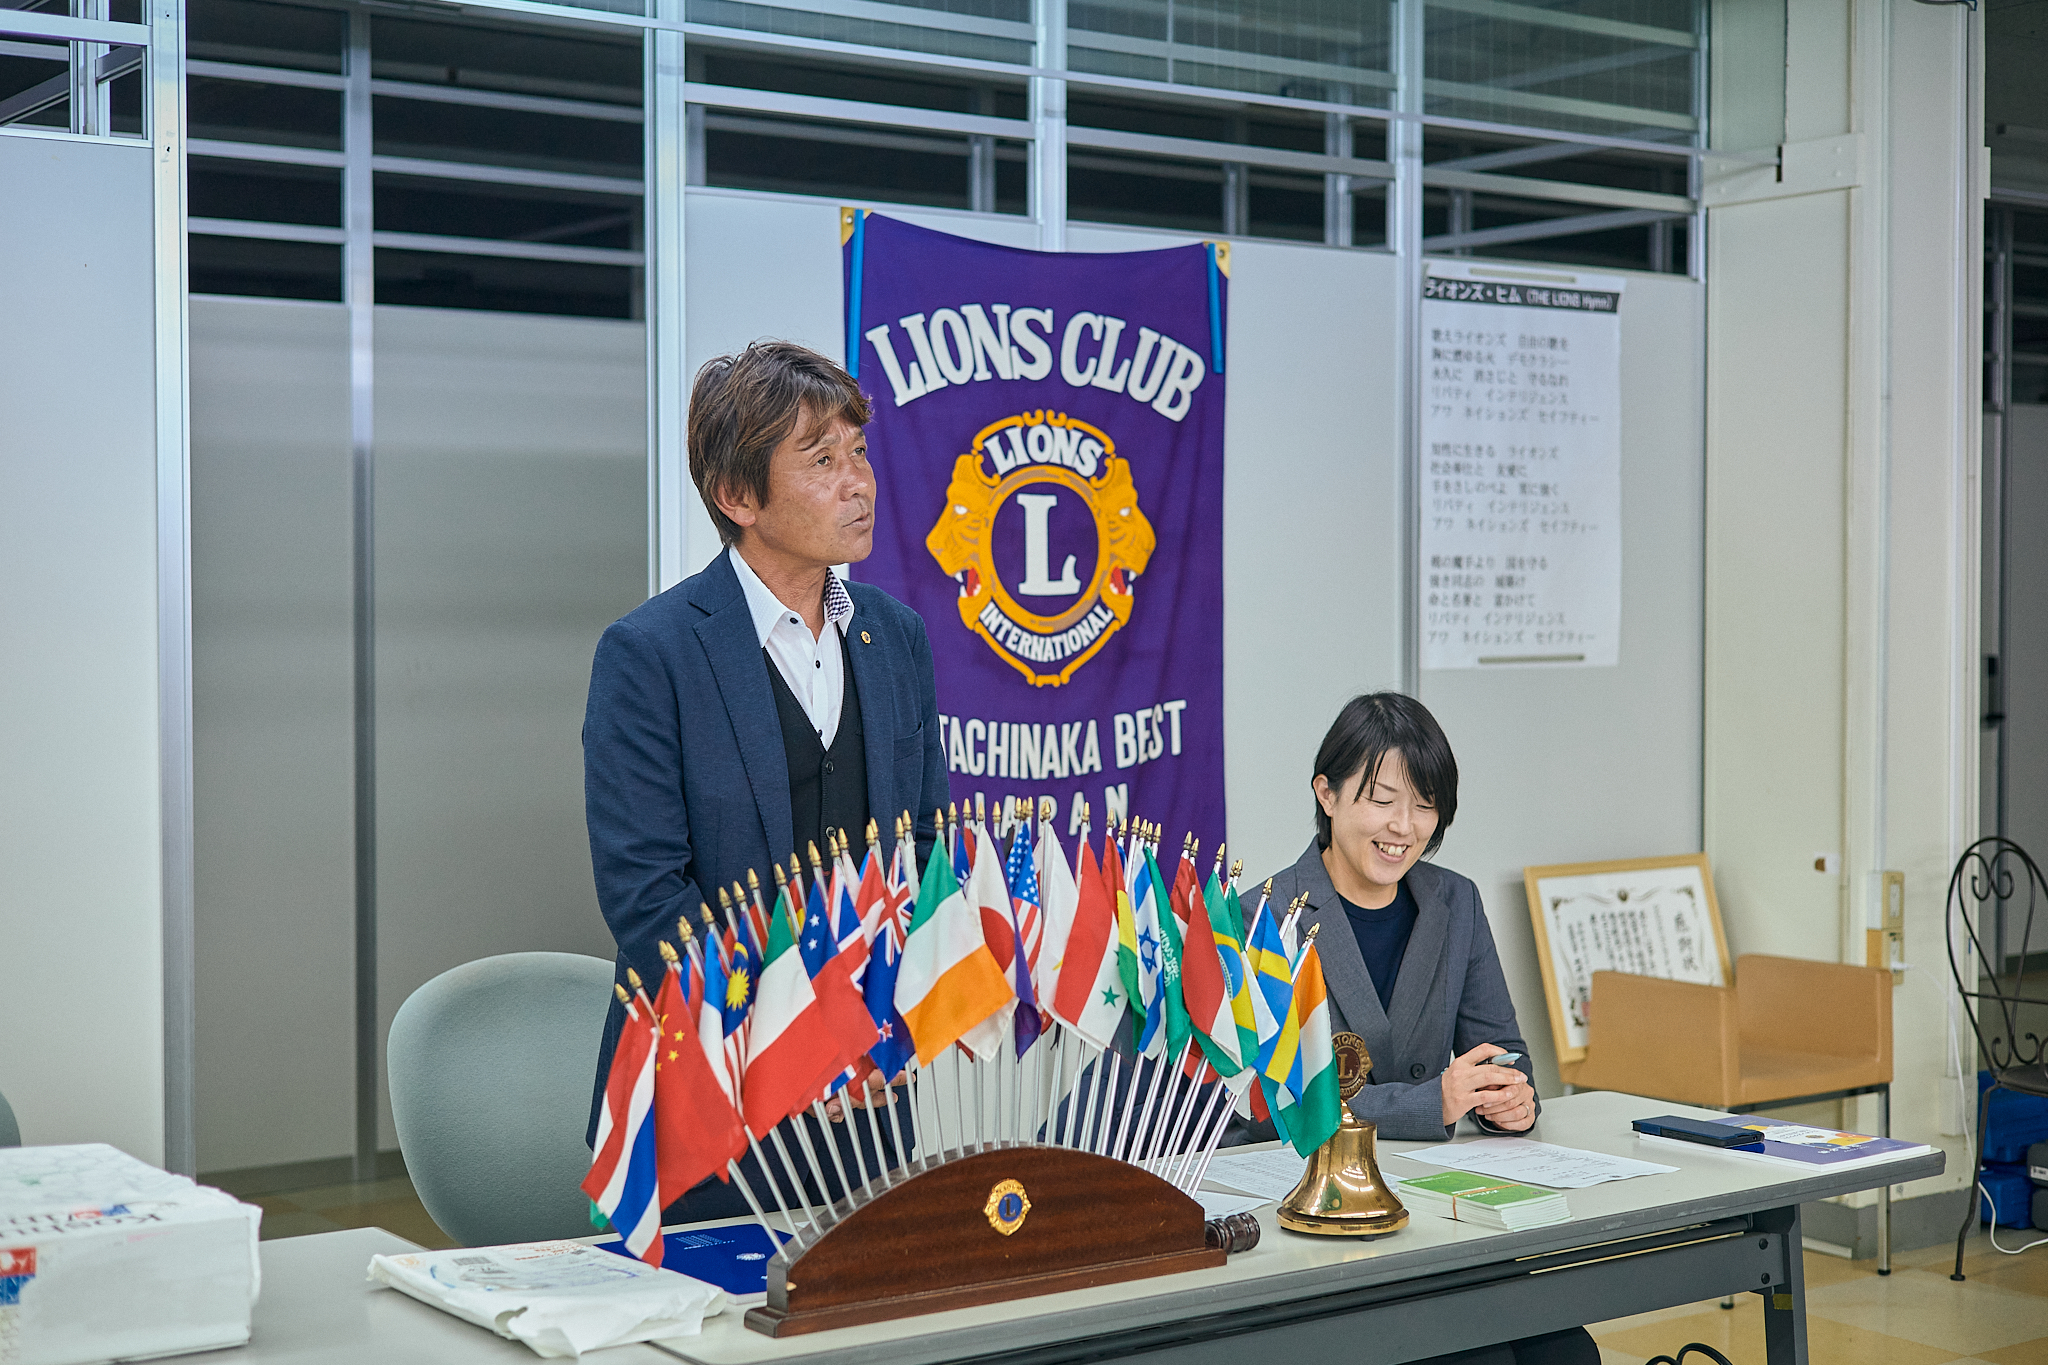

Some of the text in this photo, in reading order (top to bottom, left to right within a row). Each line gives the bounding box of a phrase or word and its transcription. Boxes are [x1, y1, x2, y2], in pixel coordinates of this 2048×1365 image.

[1425, 278, 1522, 304] ライオンズ・ヒム
[865, 303, 1206, 422] LIONS CLUB
[983, 424, 1105, 478] LIONS
[1016, 493, 1082, 596] L
[979, 601, 1115, 663] INTERNATIONAL
[1113, 699, 1187, 770] BEST
[1338, 1053, 1354, 1079] L
[1004, 1196, 1017, 1218] L
